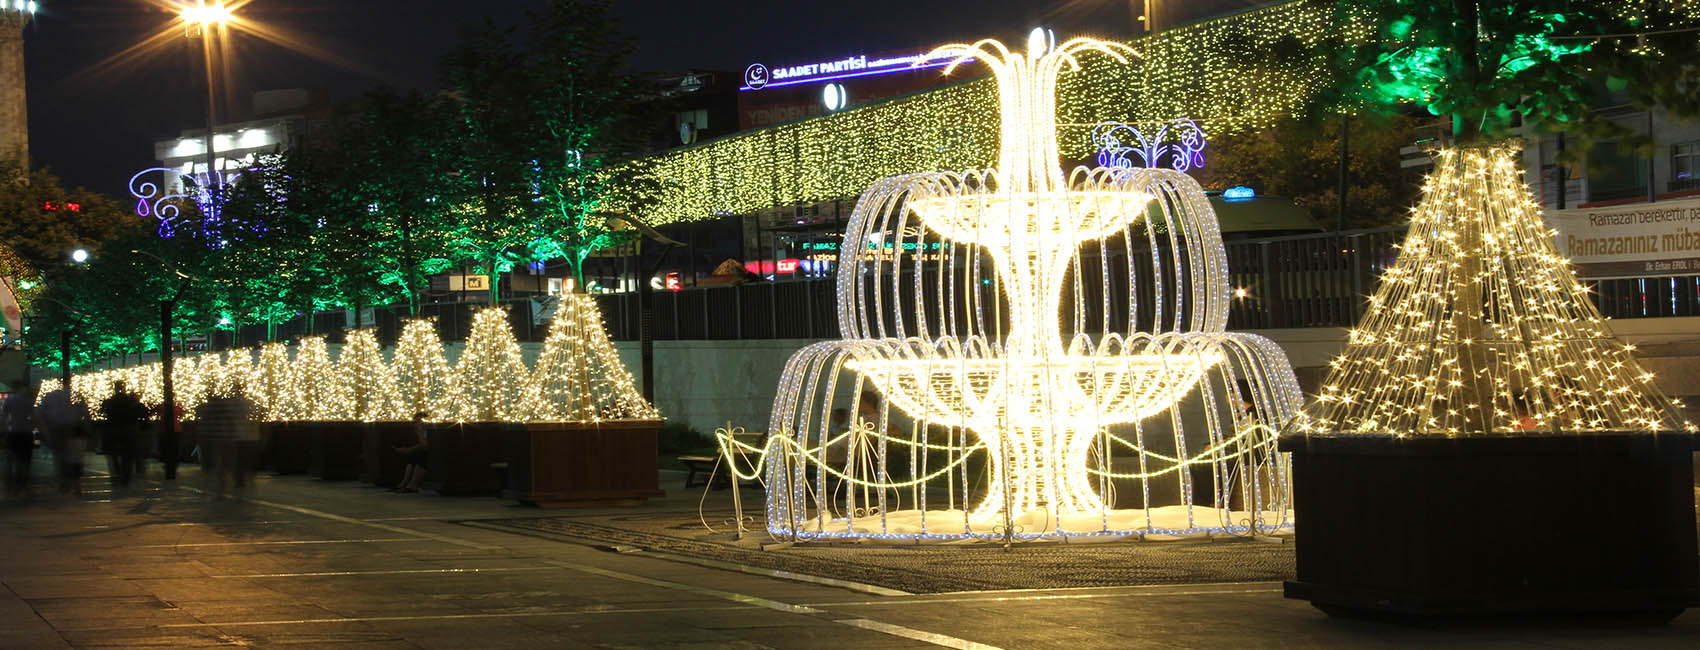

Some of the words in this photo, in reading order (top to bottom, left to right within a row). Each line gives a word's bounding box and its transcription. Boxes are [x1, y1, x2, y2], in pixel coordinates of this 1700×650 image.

[772, 64, 819, 79] SAADET
[820, 55, 866, 73] PARTİSİ
[1590, 211, 1637, 226] Ramazan
[1567, 234, 1658, 256] Ramazanınız
